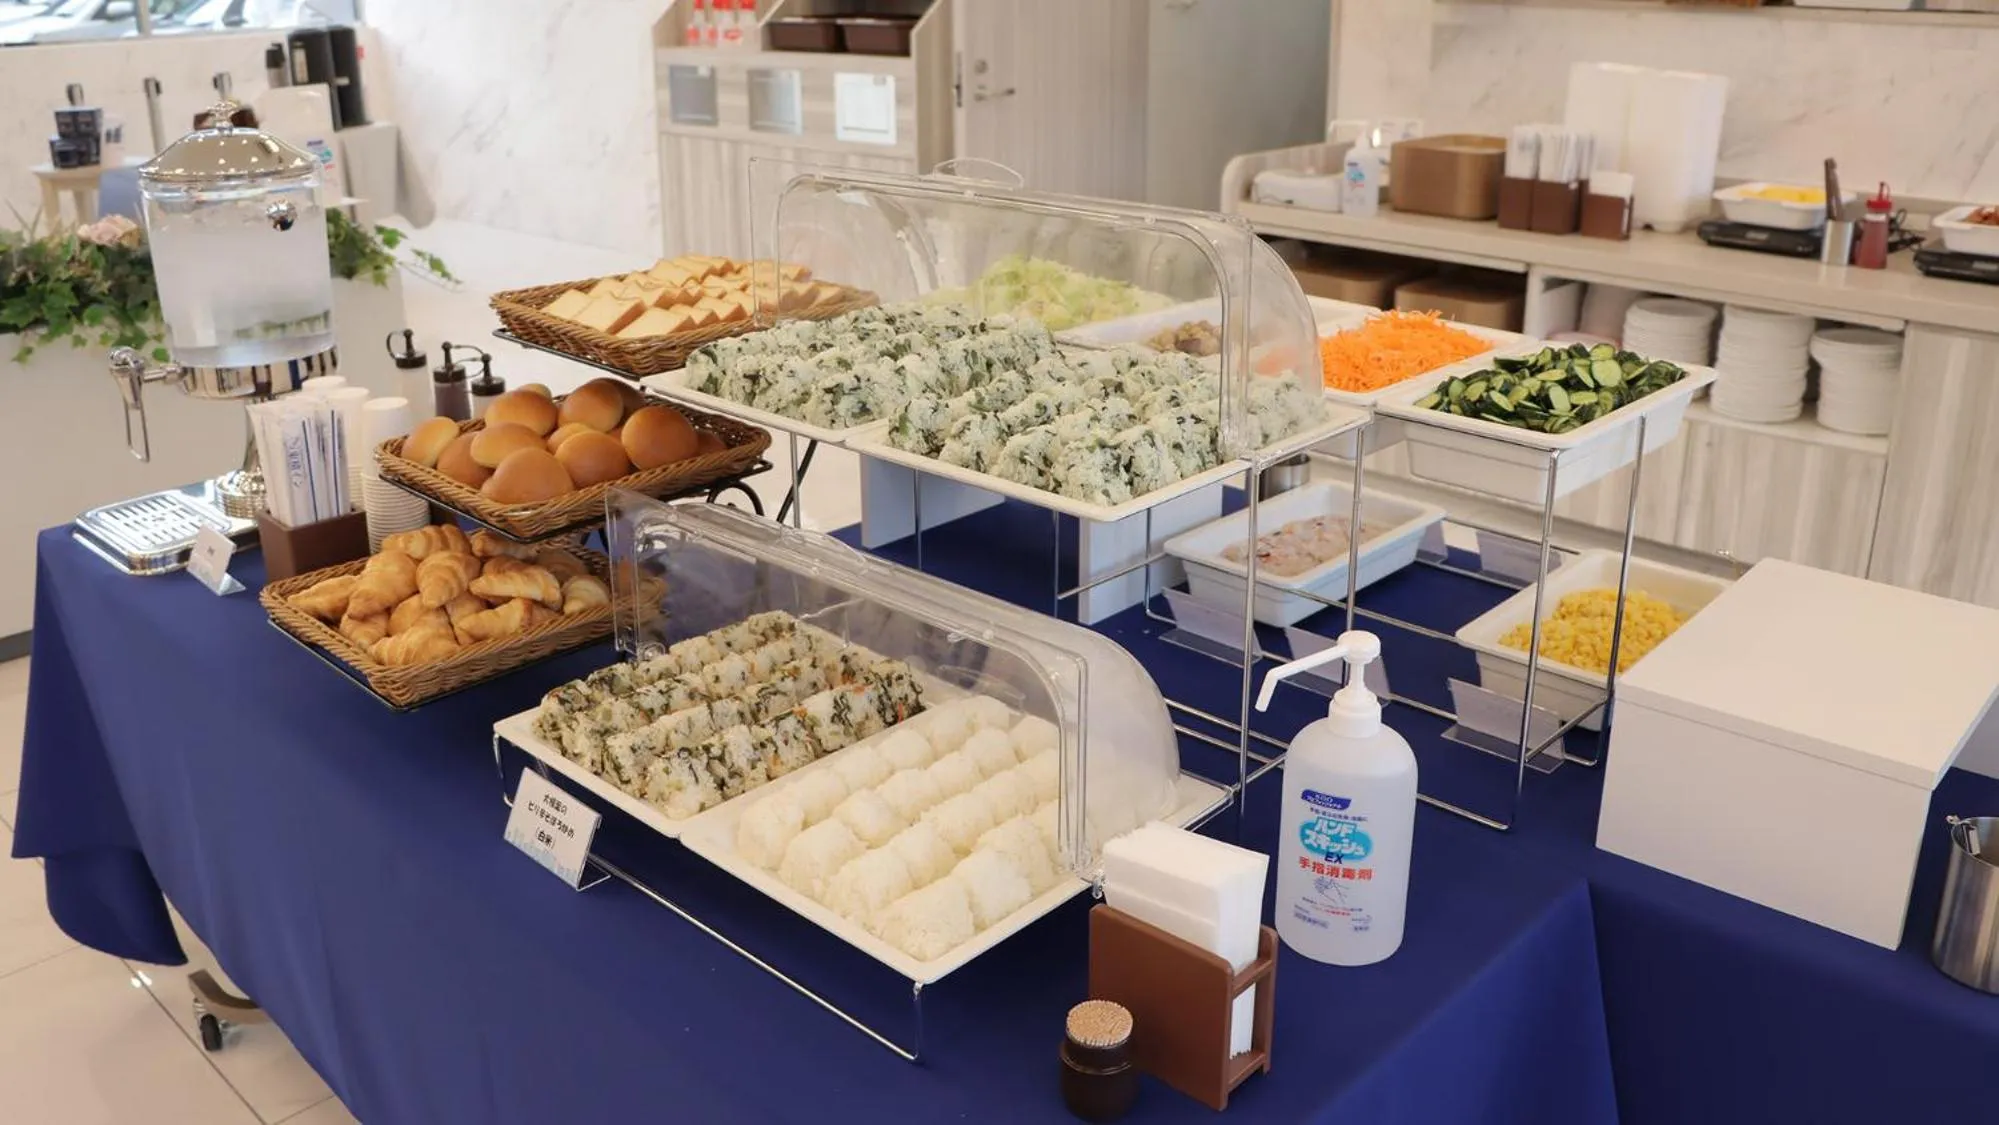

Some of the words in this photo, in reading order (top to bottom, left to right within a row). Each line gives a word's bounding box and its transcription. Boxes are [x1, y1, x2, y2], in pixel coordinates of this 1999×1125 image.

[1313, 817, 1358, 838] ハンド
[1303, 829, 1368, 857] スキッシュ
[1299, 856, 1373, 881] 手指消毒剤
[1324, 852, 1344, 864] EX
